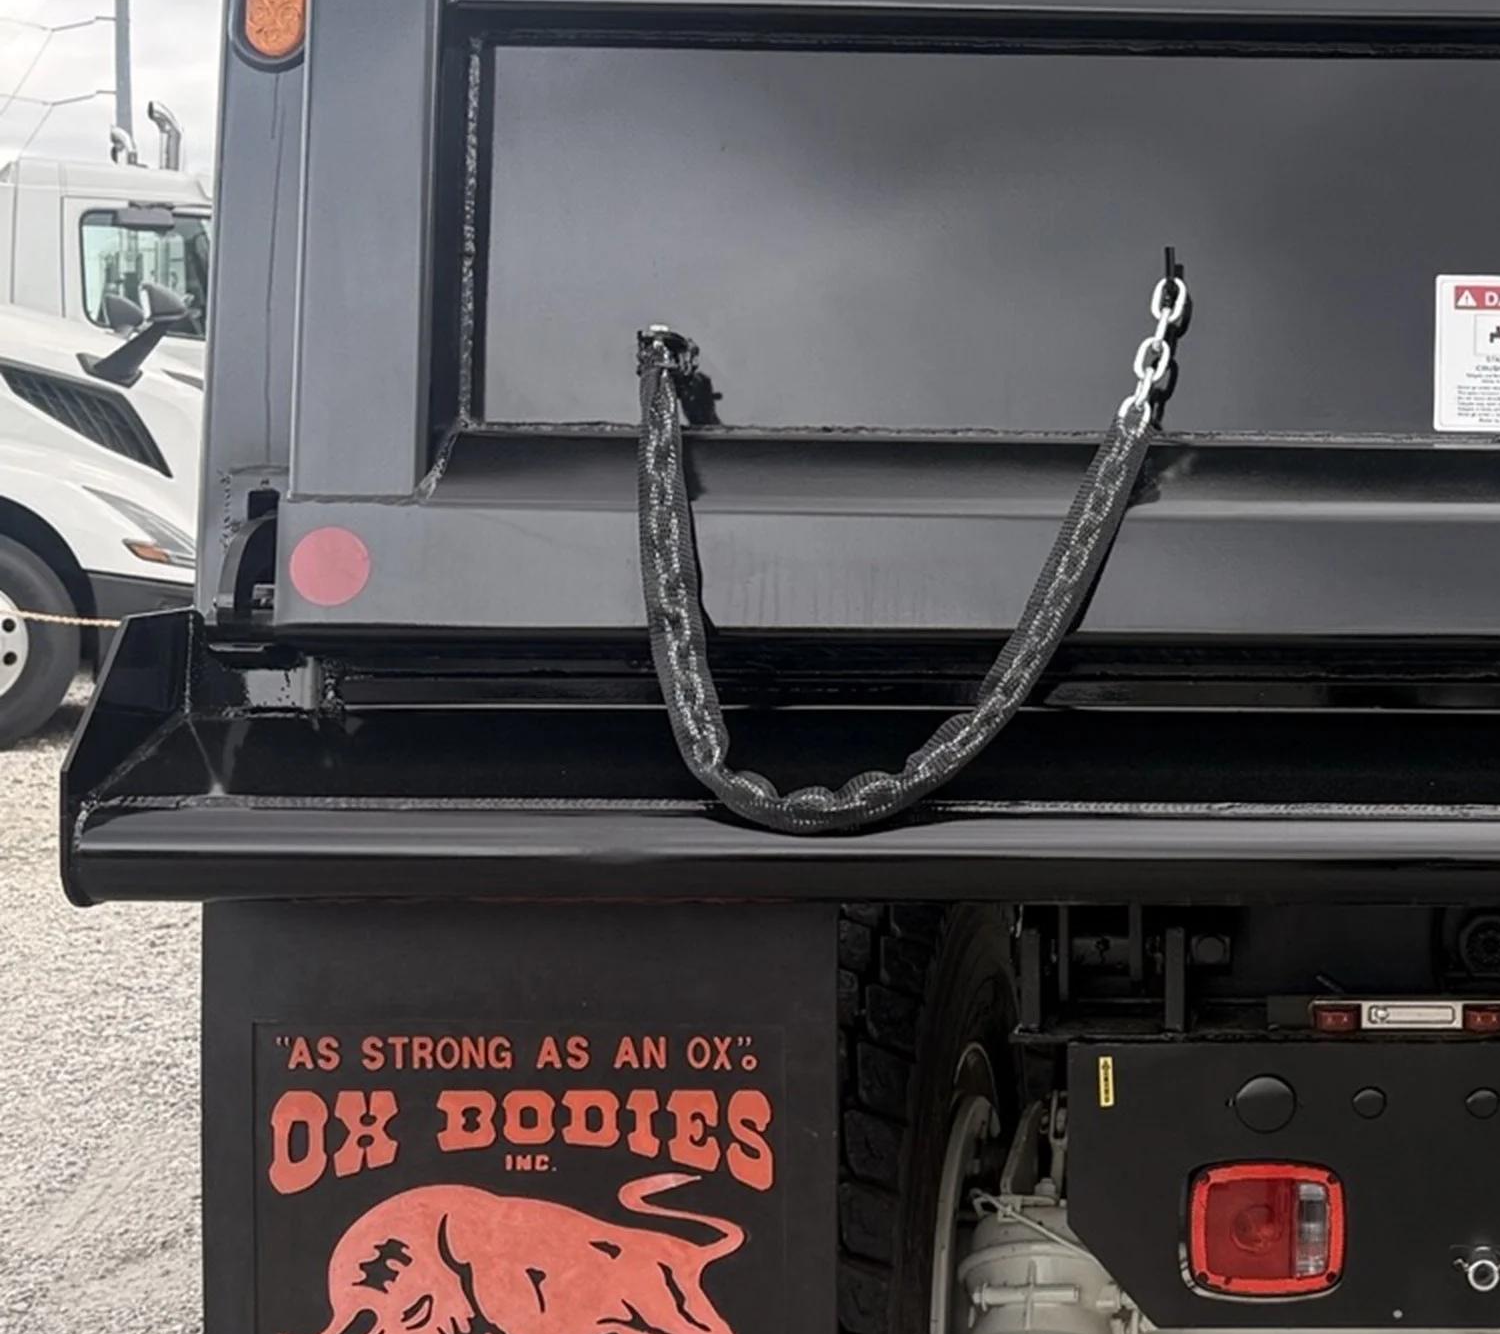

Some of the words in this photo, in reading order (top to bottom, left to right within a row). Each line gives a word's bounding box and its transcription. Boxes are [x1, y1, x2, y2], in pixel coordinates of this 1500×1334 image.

[361, 1035, 513, 1071] STRONG
[536, 1035, 590, 1070] AS
[613, 1035, 667, 1069] AN
[268, 1089, 399, 1195] OX
[436, 1088, 774, 1192] BODIES
[504, 1153, 558, 1173] INC.
